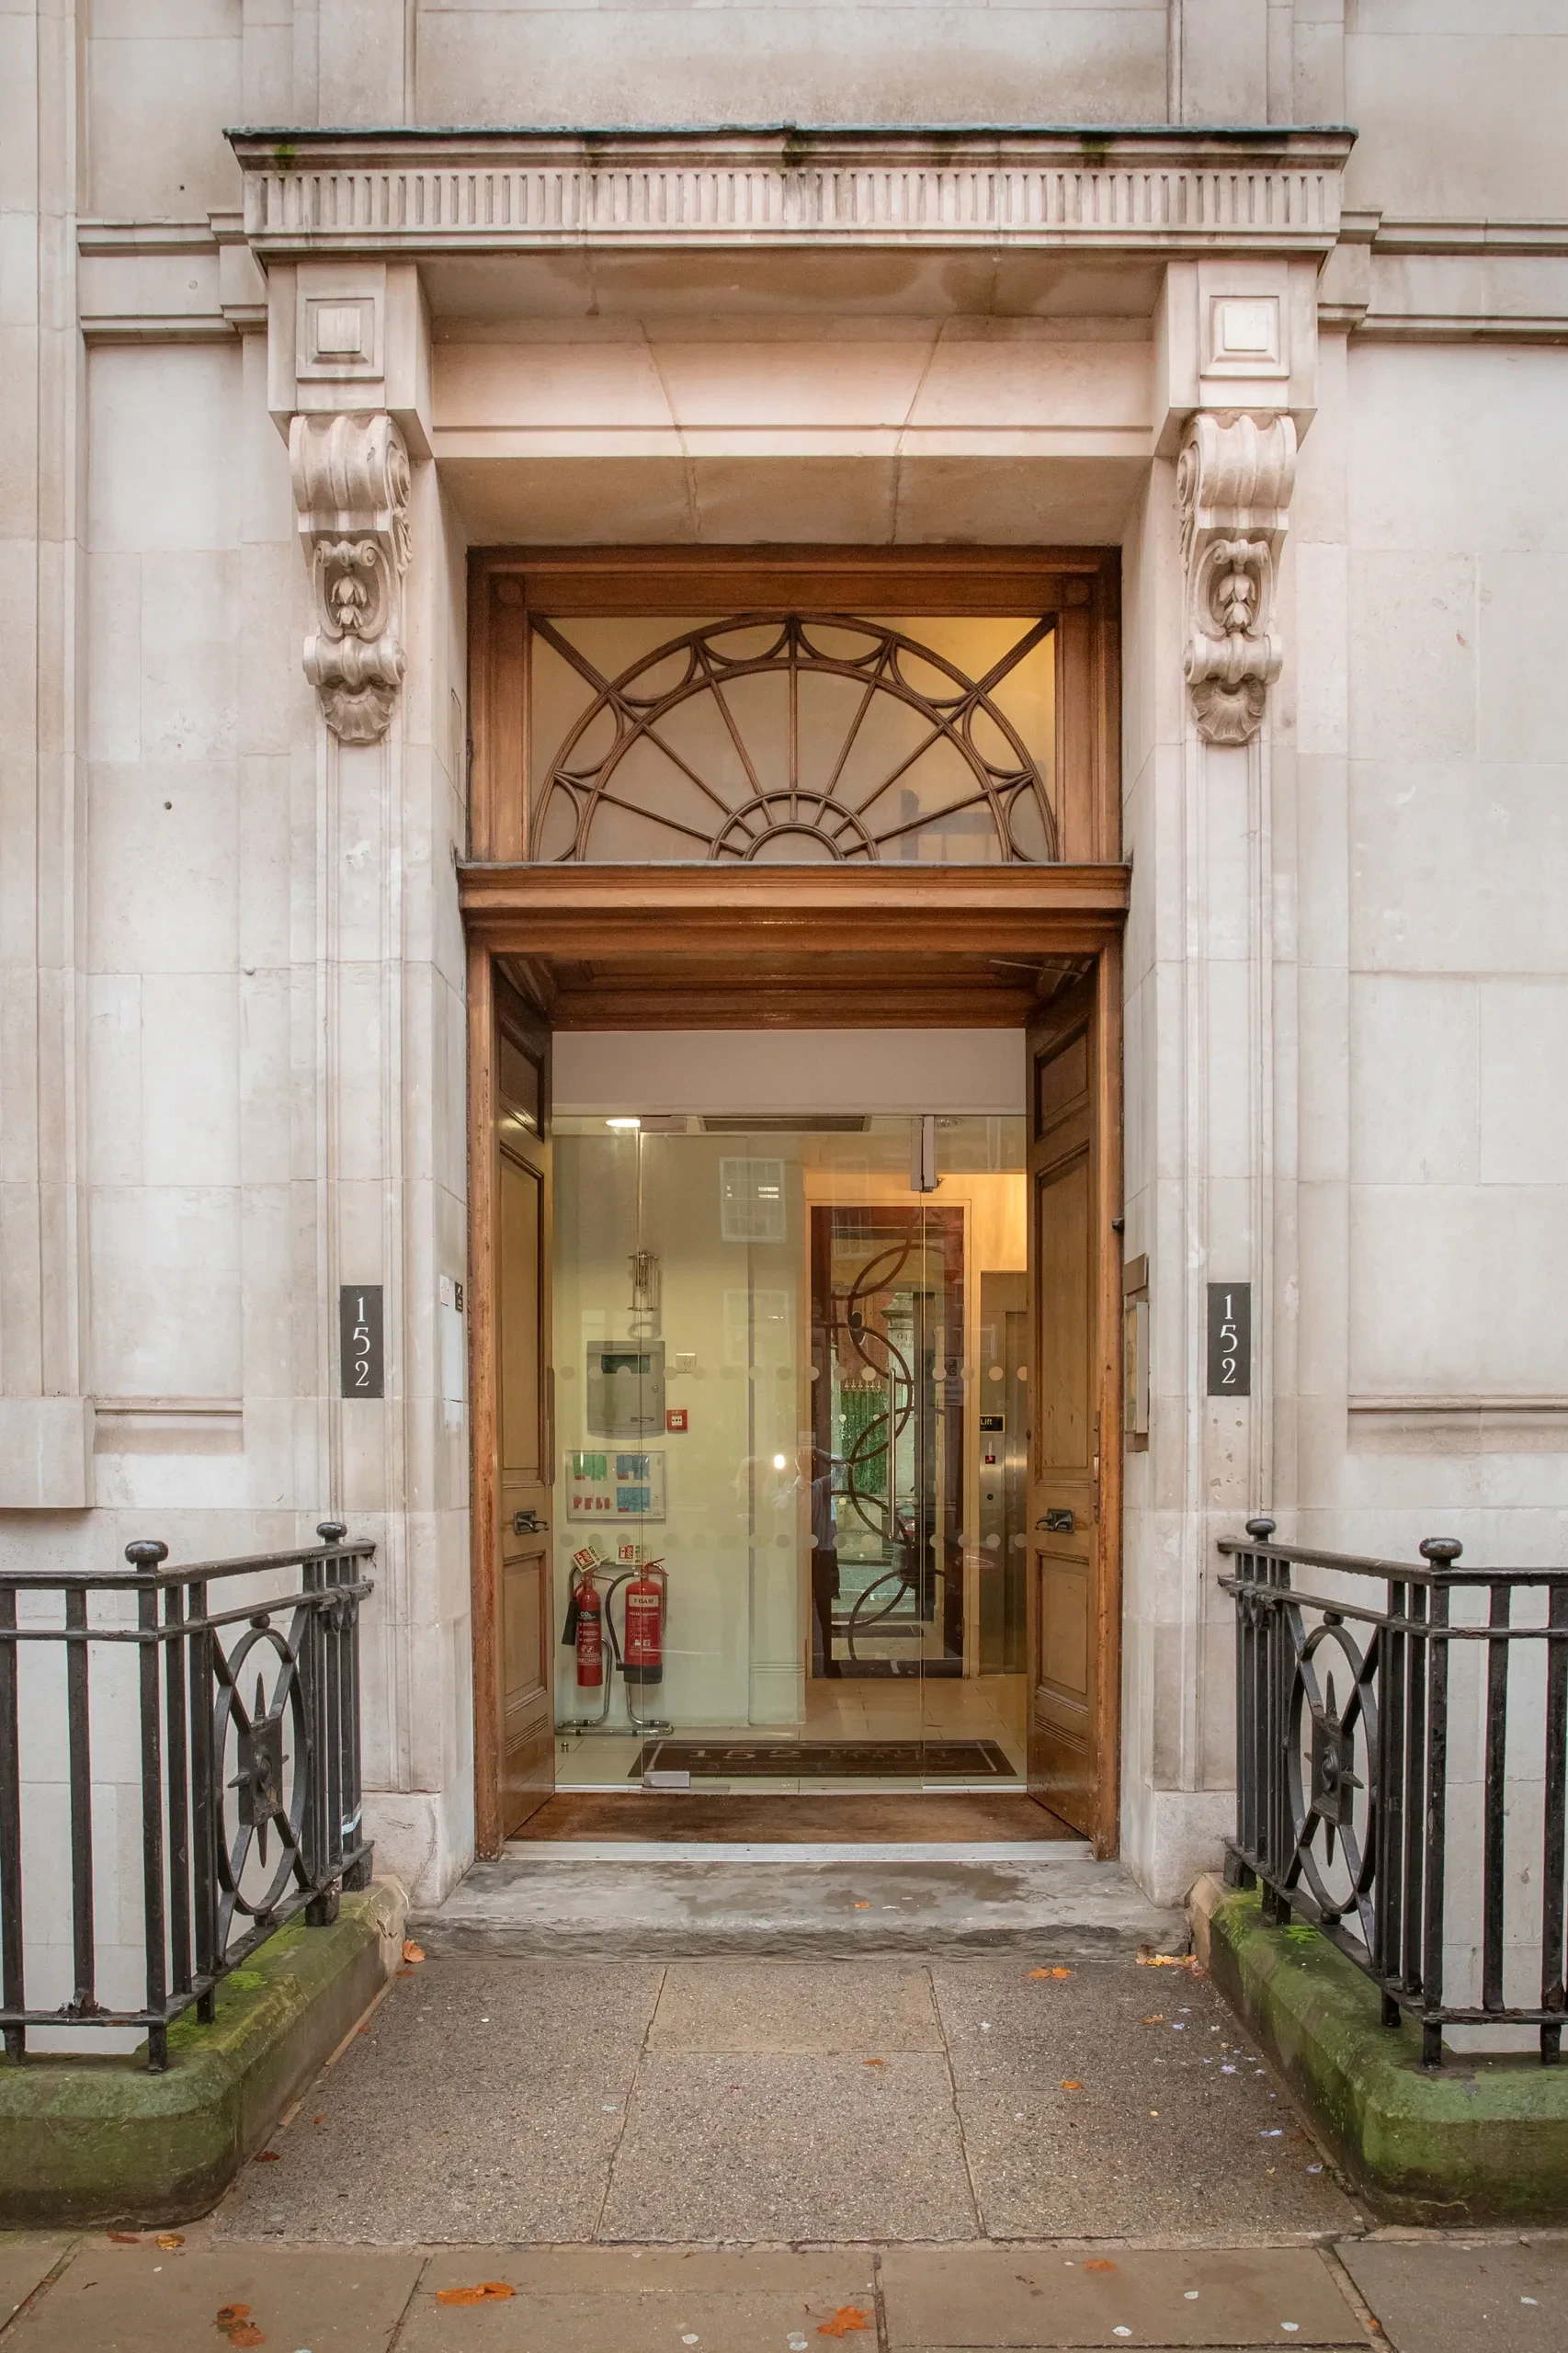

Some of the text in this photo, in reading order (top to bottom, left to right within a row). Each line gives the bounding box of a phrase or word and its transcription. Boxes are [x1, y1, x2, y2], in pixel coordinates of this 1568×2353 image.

[353, 1296, 370, 1386] 152
[1220, 1293, 1238, 1383] 152
[980, 1417, 993, 1426] Lift
[688, 1749, 802, 1760] 152
